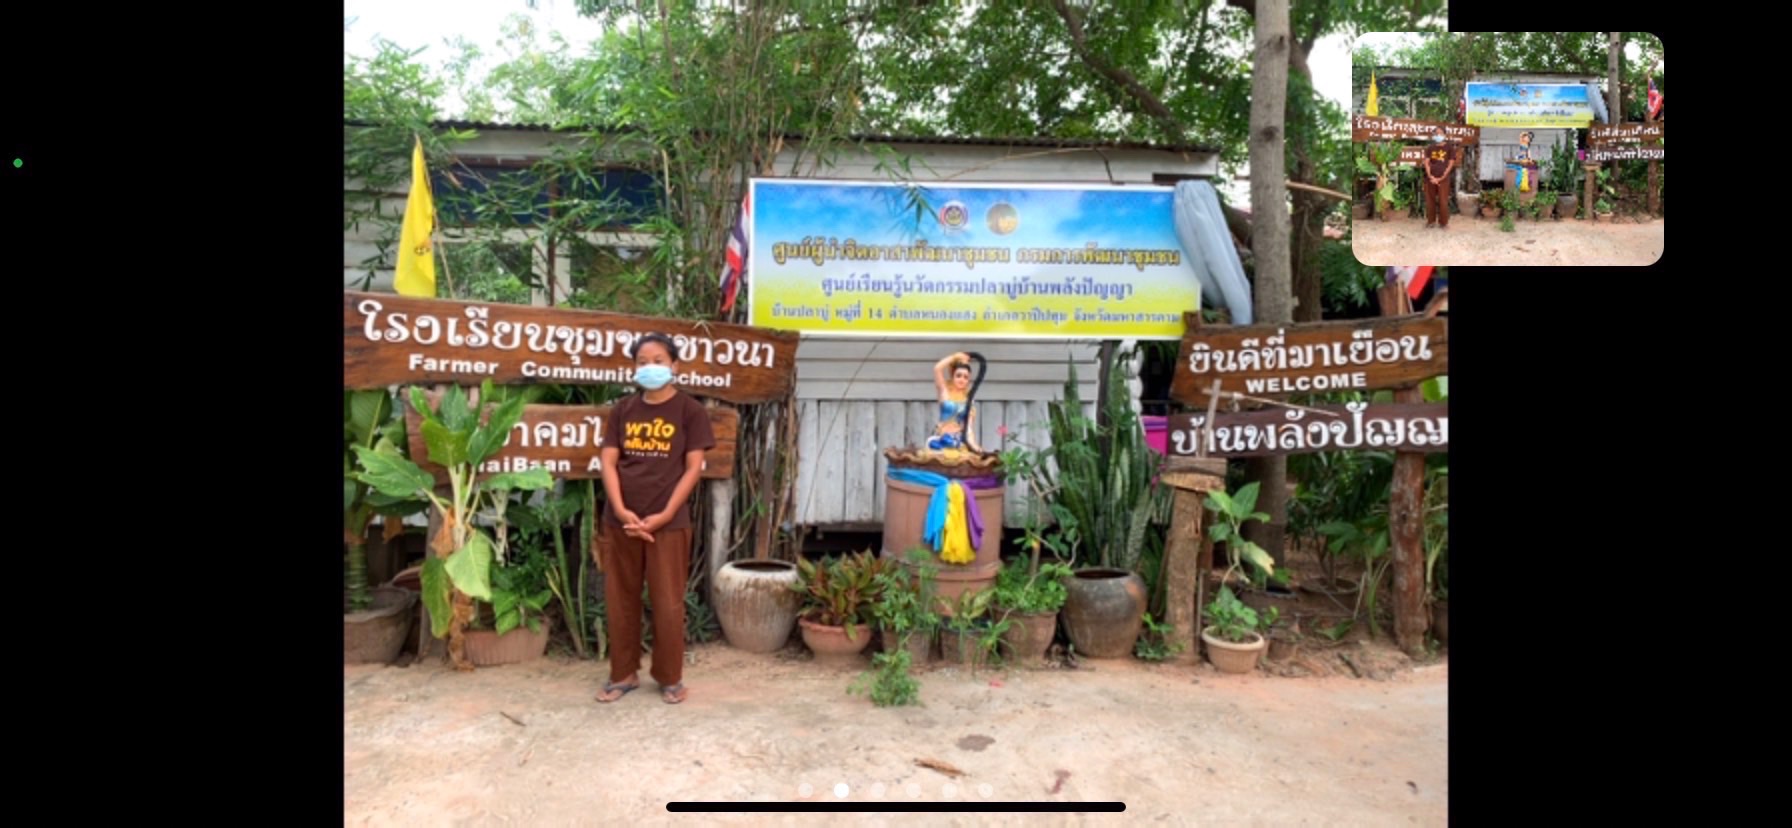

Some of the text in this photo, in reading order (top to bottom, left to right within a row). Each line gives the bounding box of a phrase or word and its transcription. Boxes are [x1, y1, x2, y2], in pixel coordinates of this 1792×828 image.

[868, 307, 883, 319] 14
[358, 300, 776, 369] โรงเรียนชุมชชาวนา
[1189, 329, 1433, 374] ยินดีที่มาเยือน
[409, 353, 731, 388] Farmer Communit chool
[1246, 371, 1367, 394] WELCOME
[625, 417, 675, 438] พาใจ
[623, 437, 671, 451] กลับบ้าน
[478, 457, 571, 473] aiBaan
